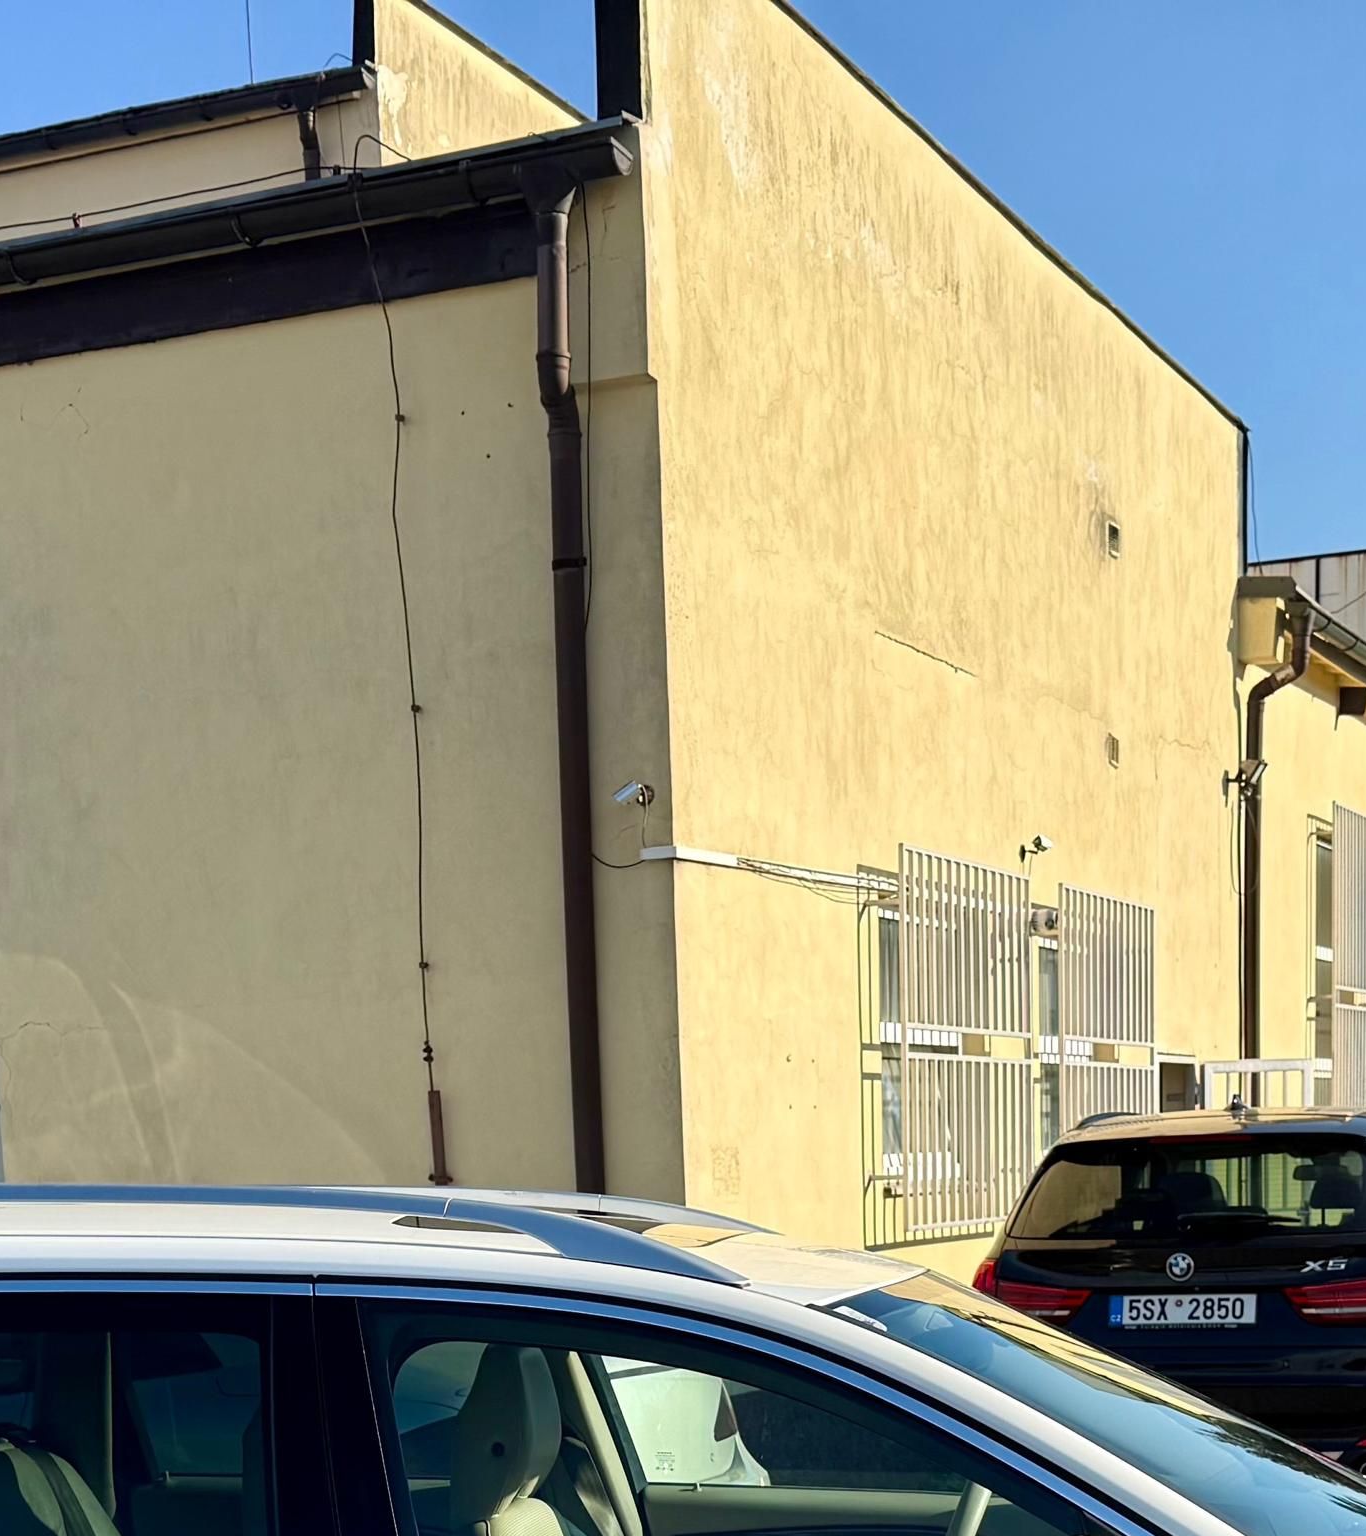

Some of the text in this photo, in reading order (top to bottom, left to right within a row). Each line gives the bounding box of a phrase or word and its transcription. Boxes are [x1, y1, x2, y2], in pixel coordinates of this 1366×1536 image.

[1299, 1259, 1349, 1273] X5
[1128, 1297, 1245, 1321] 5SX 2850
